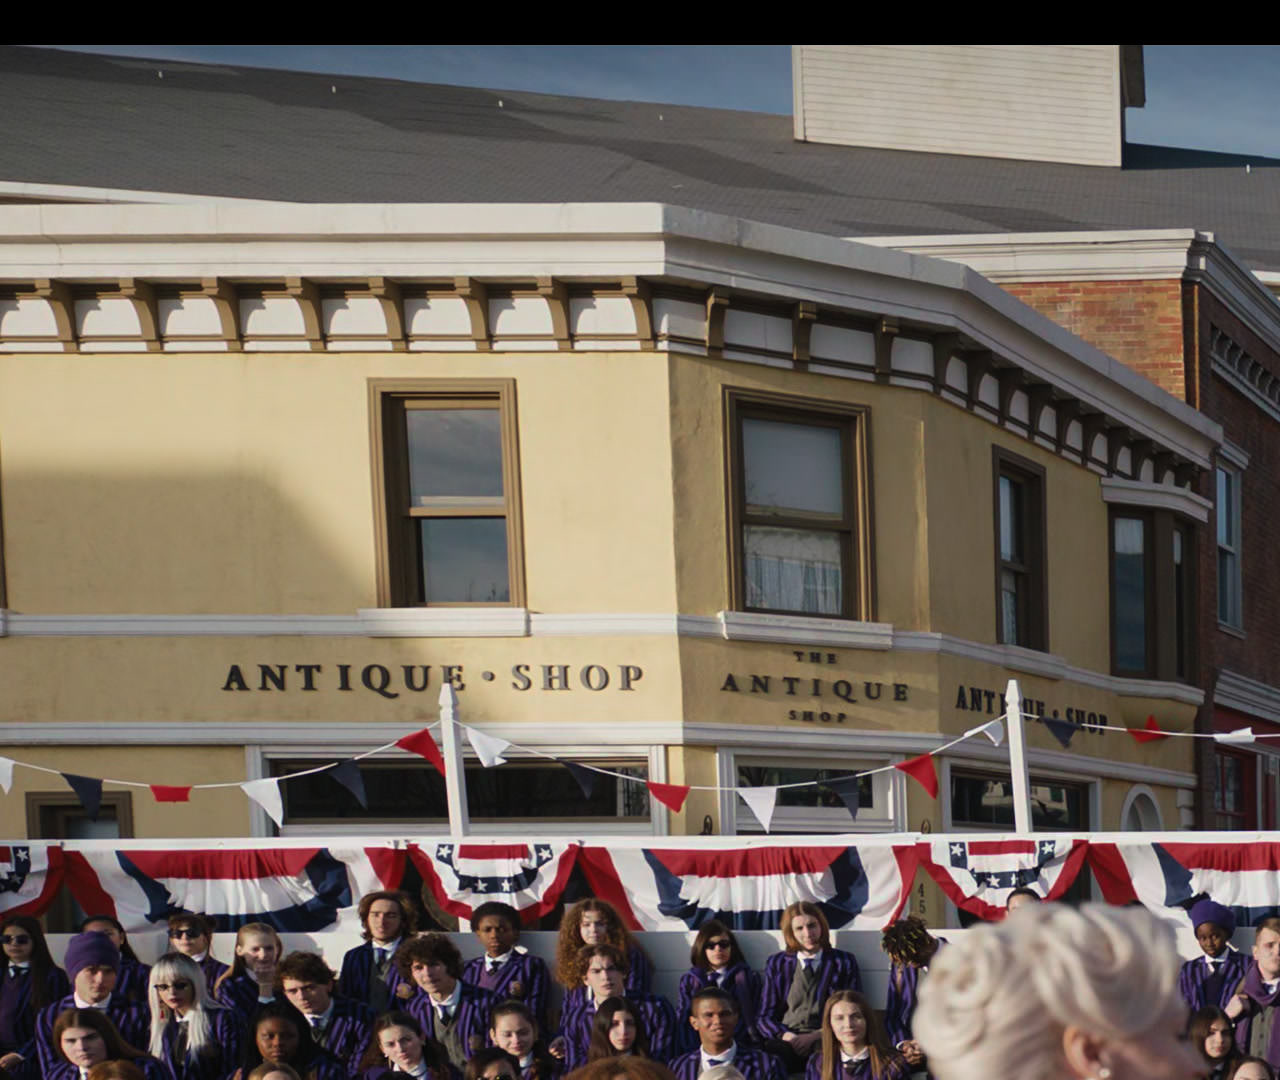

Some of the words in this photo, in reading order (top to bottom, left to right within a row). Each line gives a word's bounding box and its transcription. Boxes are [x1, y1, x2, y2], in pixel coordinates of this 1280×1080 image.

[793, 651, 839, 664] THE
[221, 664, 466, 699] ANTIQUE
[511, 664, 644, 692] SHOP
[720, 673, 910, 704] ANTIQUE
[789, 709, 848, 724] SHOP
[956, 685, 1047, 721] ANTIUE
[1065, 706, 1108, 737] SHOP
